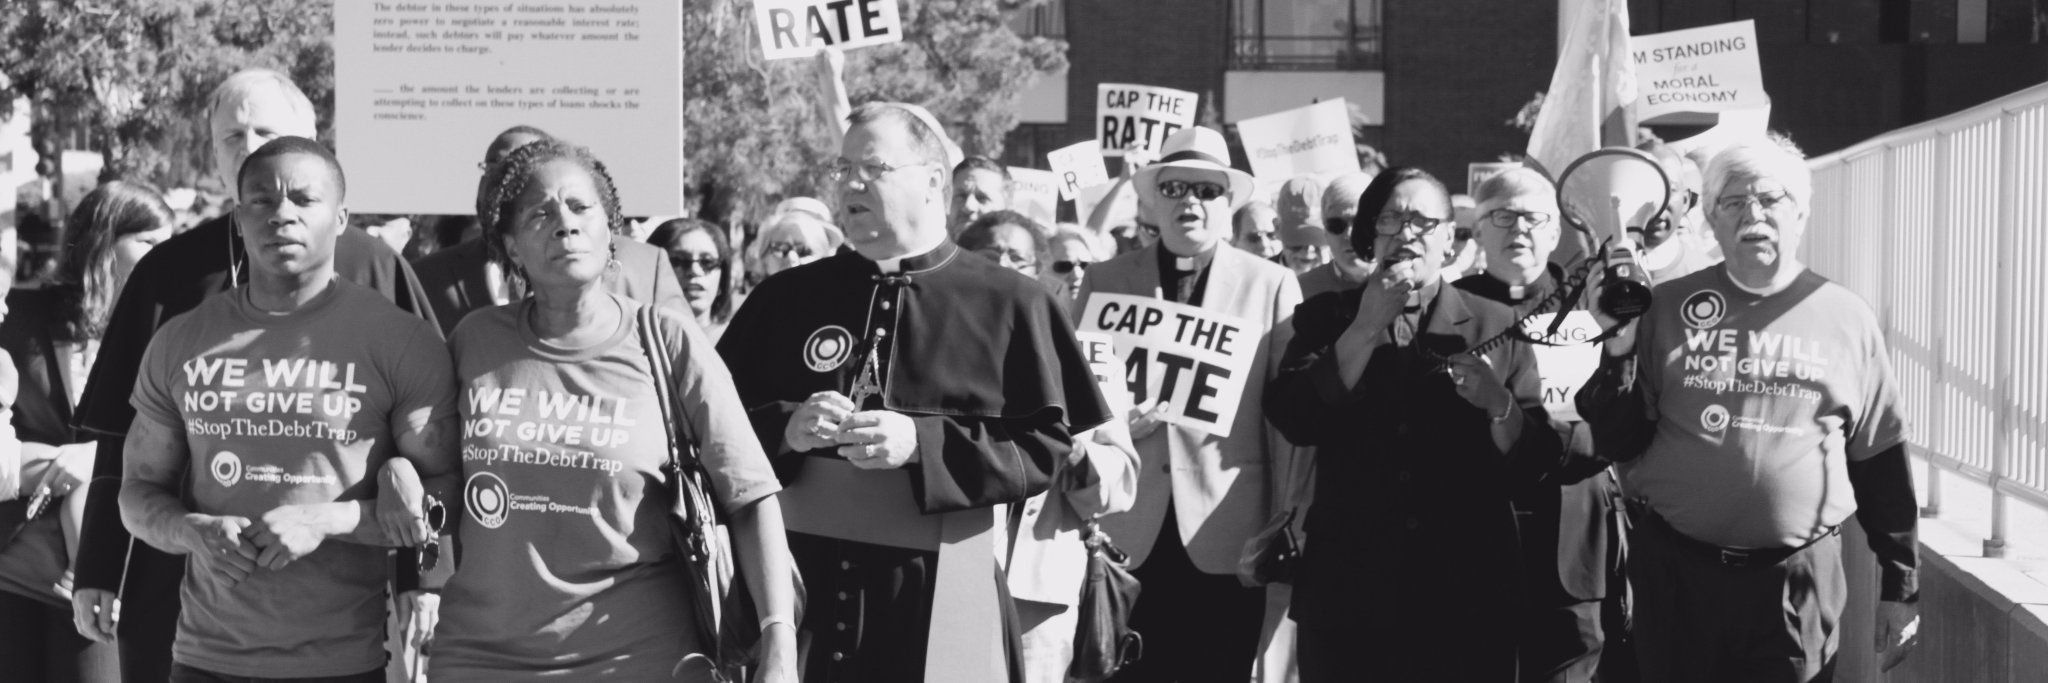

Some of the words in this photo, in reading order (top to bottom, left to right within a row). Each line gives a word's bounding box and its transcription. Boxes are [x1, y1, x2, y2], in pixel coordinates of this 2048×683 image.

[374, 3, 391, 12] The
[395, 3, 427, 12] debtor
[431, 3, 441, 12] in
[445, 4, 470, 12] these
[474, 4, 500, 14] types
[503, 4, 514, 12] of
[517, 4, 564, 13] situations
[568, 4, 585, 13] has
[589, 4, 639, 14] absolutely
[373, 18, 394, 26] zero
[399, 18, 429, 28] power
[435, 18, 445, 26] to
[451, 18, 495, 28] negotiate
[513, 18, 566, 27] reasonable
[572, 18, 609, 27] interest
[415, 30, 437, 39] such
[442, 30, 479, 39] debtors
[485, 31, 501, 40] will
[507, 33, 524, 42] pay
[531, 32, 576, 41] whatever
[581, 33, 619, 41] amount
[624, 32, 640, 41] the
[768, 0, 889, 50] RATE
[373, 43, 402, 53] lender
[406, 43, 442, 53] decides
[444, 44, 455, 53] to
[1653, 36, 1747, 63] STANDING
[400, 83, 415, 94] the
[421, 84, 458, 94] amount
[465, 84, 480, 94] the
[487, 84, 523, 94] lenders
[529, 86, 545, 95] are
[551, 85, 600, 97] collecting
[605, 87, 617, 95] or
[623, 87, 640, 96] are
[1653, 74, 1720, 90] MORAL
[373, 98, 426, 108] attempting
[429, 98, 439, 107] to
[441, 98, 472, 107] collect
[490, 99, 515, 108] these
[518, 99, 544, 110] types
[546, 99, 557, 109] of
[560, 99, 586, 109] loans
[588, 99, 622, 109] shocks
[624, 99, 640, 109] the
[1106, 89, 1140, 109] CAP
[1147, 92, 1184, 116] THE
[1646, 90, 1738, 106] ECONOMY
[1097, 302, 1163, 335] CAP
[1174, 313, 1240, 356] THE
[1684, 328, 1738, 353] WE
[1748, 330, 1829, 366] WILL
[183, 358, 248, 387] WE
[262, 358, 367, 394] WILL
[1684, 354, 1733, 373] NOT
[1737, 357, 1790, 378] GIVE
[1795, 365, 1826, 382] UP
[1125, 346, 1232, 424] ATE
[1683, 374, 1822, 404] #StopTheDebtTrap
[184, 390, 238, 413] NOT
[246, 391, 314, 414] GIVE
[322, 394, 362, 419] UP
[468, 387, 526, 416] WE
[538, 390, 636, 427] WILL
[187, 417, 357, 445] #StopTheDebtTrap
[463, 418, 512, 440] NOT
[516, 421, 583, 445] GIVE
[590, 427, 630, 449] UP
[462, 443, 623, 477] #StopTheDebtTrap
[245, 472, 282, 484] Creating
[509, 493, 550, 502] Communities
[510, 501, 547, 513] Creating
[483, 515, 501, 528] CCO
